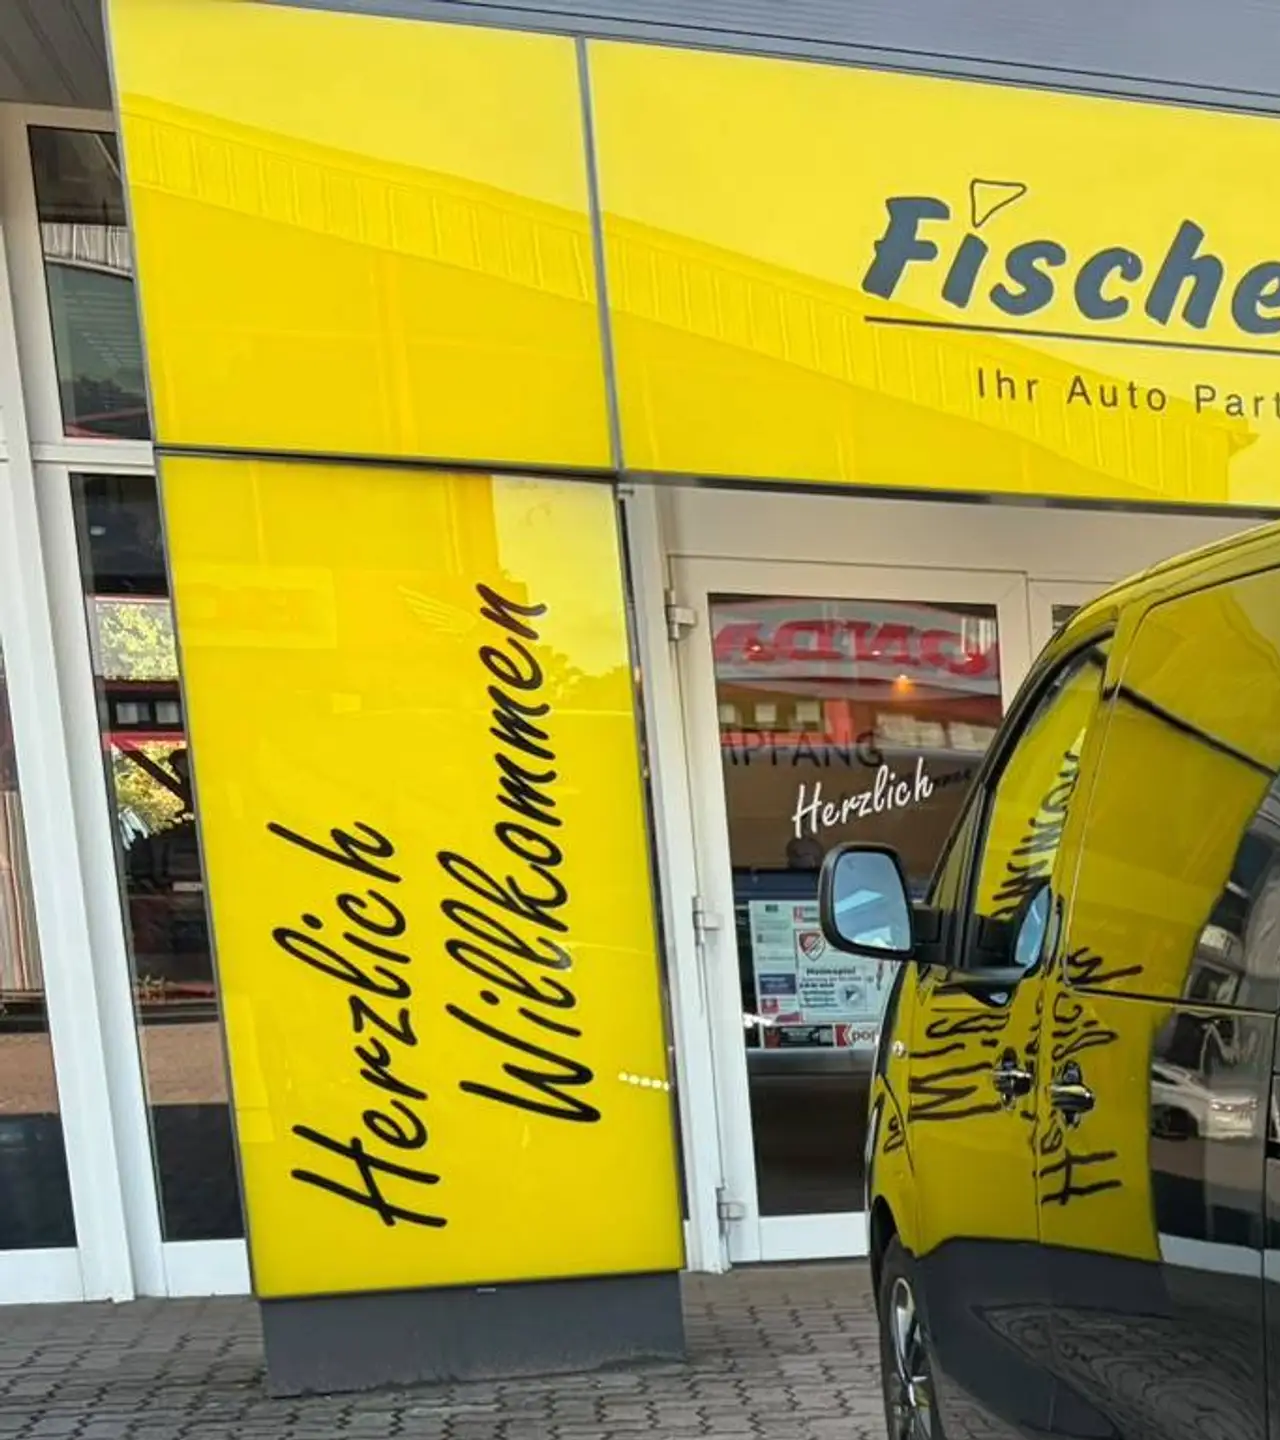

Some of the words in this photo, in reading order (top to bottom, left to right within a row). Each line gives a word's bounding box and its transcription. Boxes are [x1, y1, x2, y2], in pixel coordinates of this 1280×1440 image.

[977, 366, 1040, 401] Ihr
[1066, 375, 1167, 413] Auto
[436, 583, 601, 1123] Willkommen
[791, 756, 933, 839] Herzlich
[267, 821, 448, 1228] Herzlich
